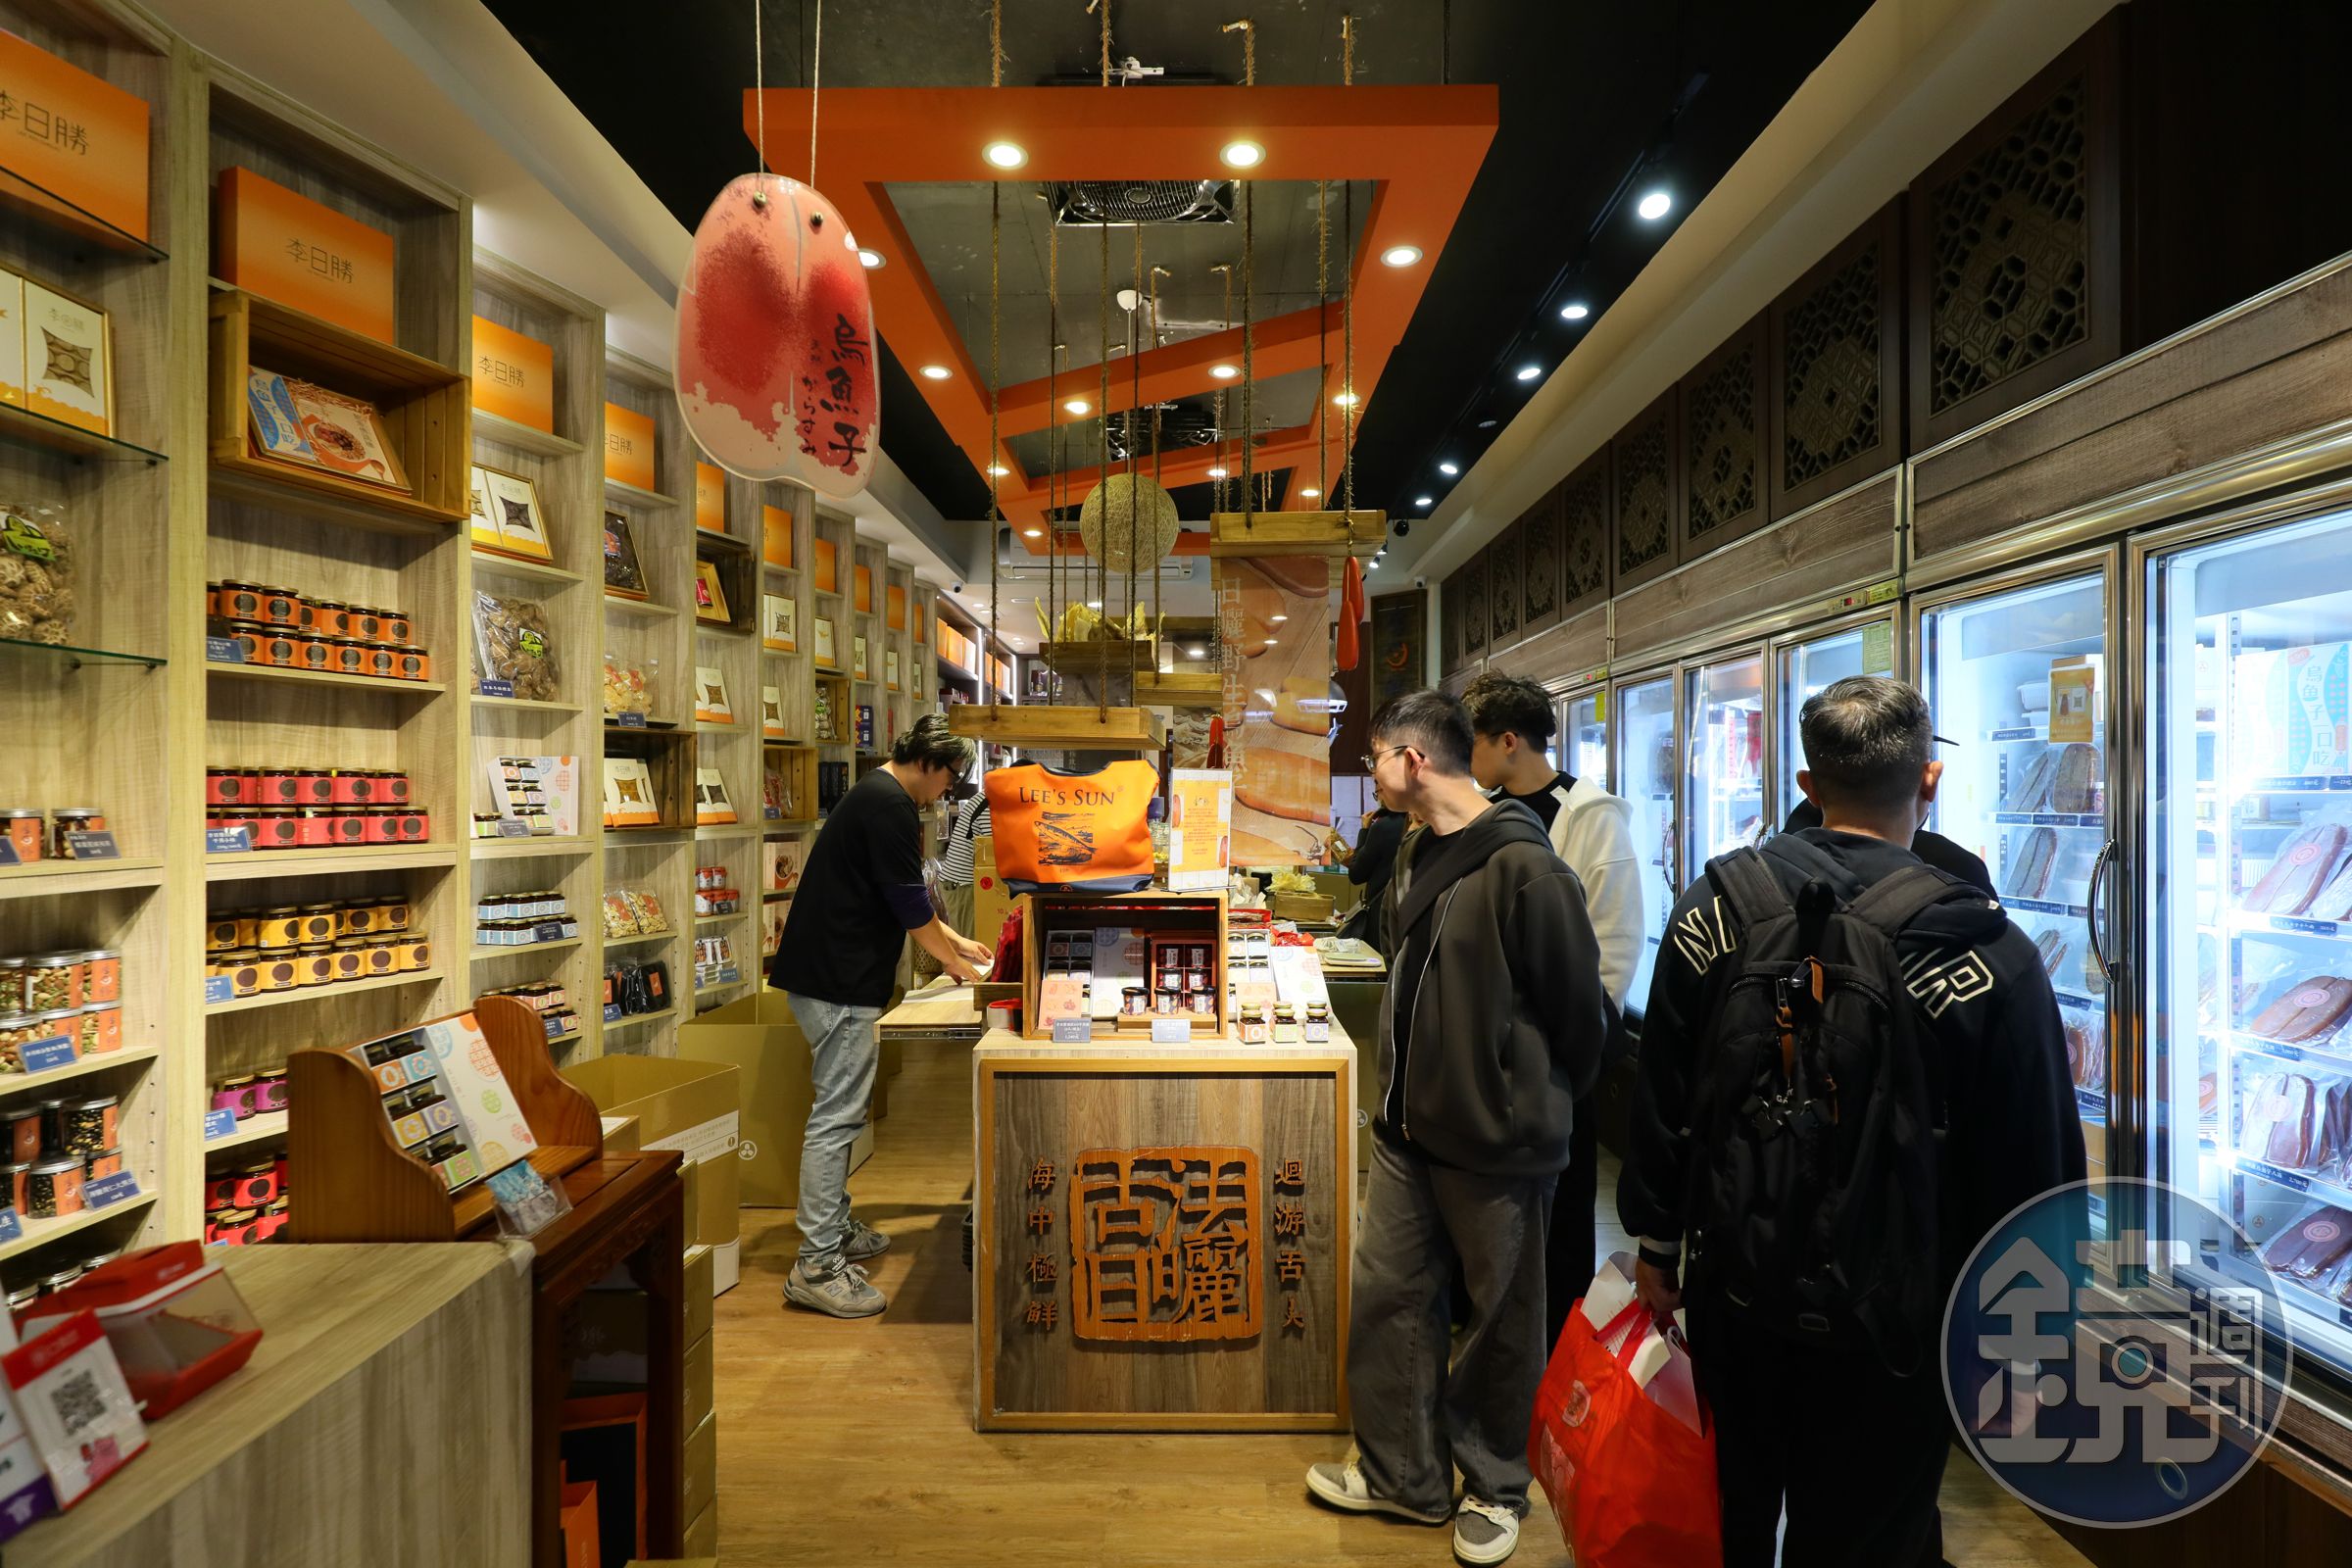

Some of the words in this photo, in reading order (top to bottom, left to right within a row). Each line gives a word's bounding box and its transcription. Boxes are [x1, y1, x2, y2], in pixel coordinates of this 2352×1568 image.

[285, 237, 354, 284] 李日勝
[477, 355, 526, 389] 李日勝
[604, 433, 635, 456] 日勝
[2302, 665, 2333, 766] 烏魚子一口吃
[1019, 786, 1066, 806] LEE'S
[1073, 788, 1115, 807] SUN
[1026, 1156, 1058, 1331] 海中極鮮
